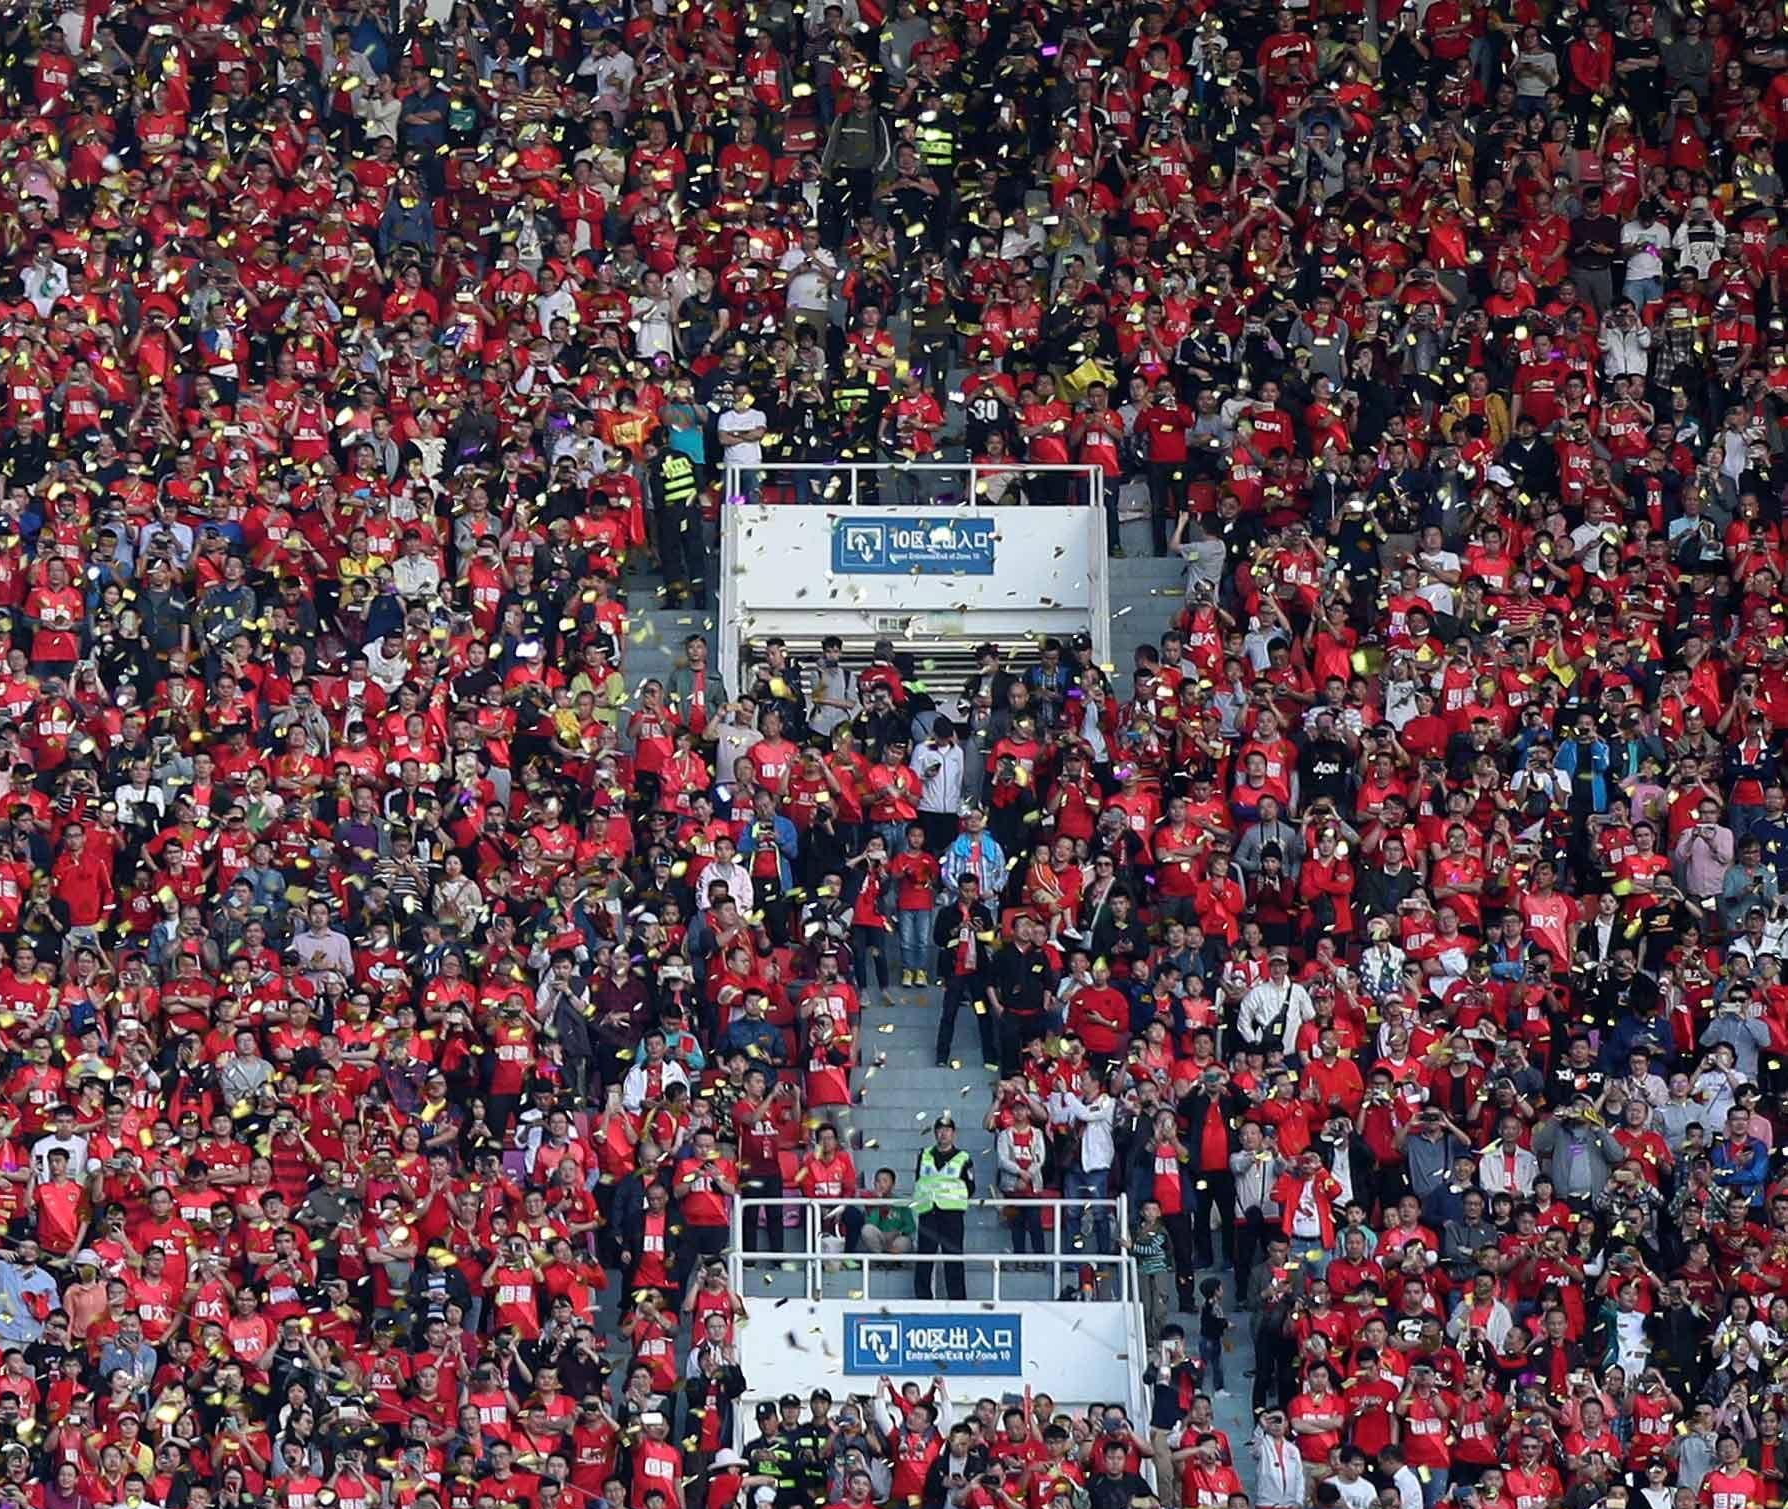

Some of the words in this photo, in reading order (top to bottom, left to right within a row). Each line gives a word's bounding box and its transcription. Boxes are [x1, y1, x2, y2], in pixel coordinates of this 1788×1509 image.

[973, 399, 998, 421] 30
[1530, 914, 1558, 929] 恒大
[906, 1327, 1012, 1349] 10区出入口
